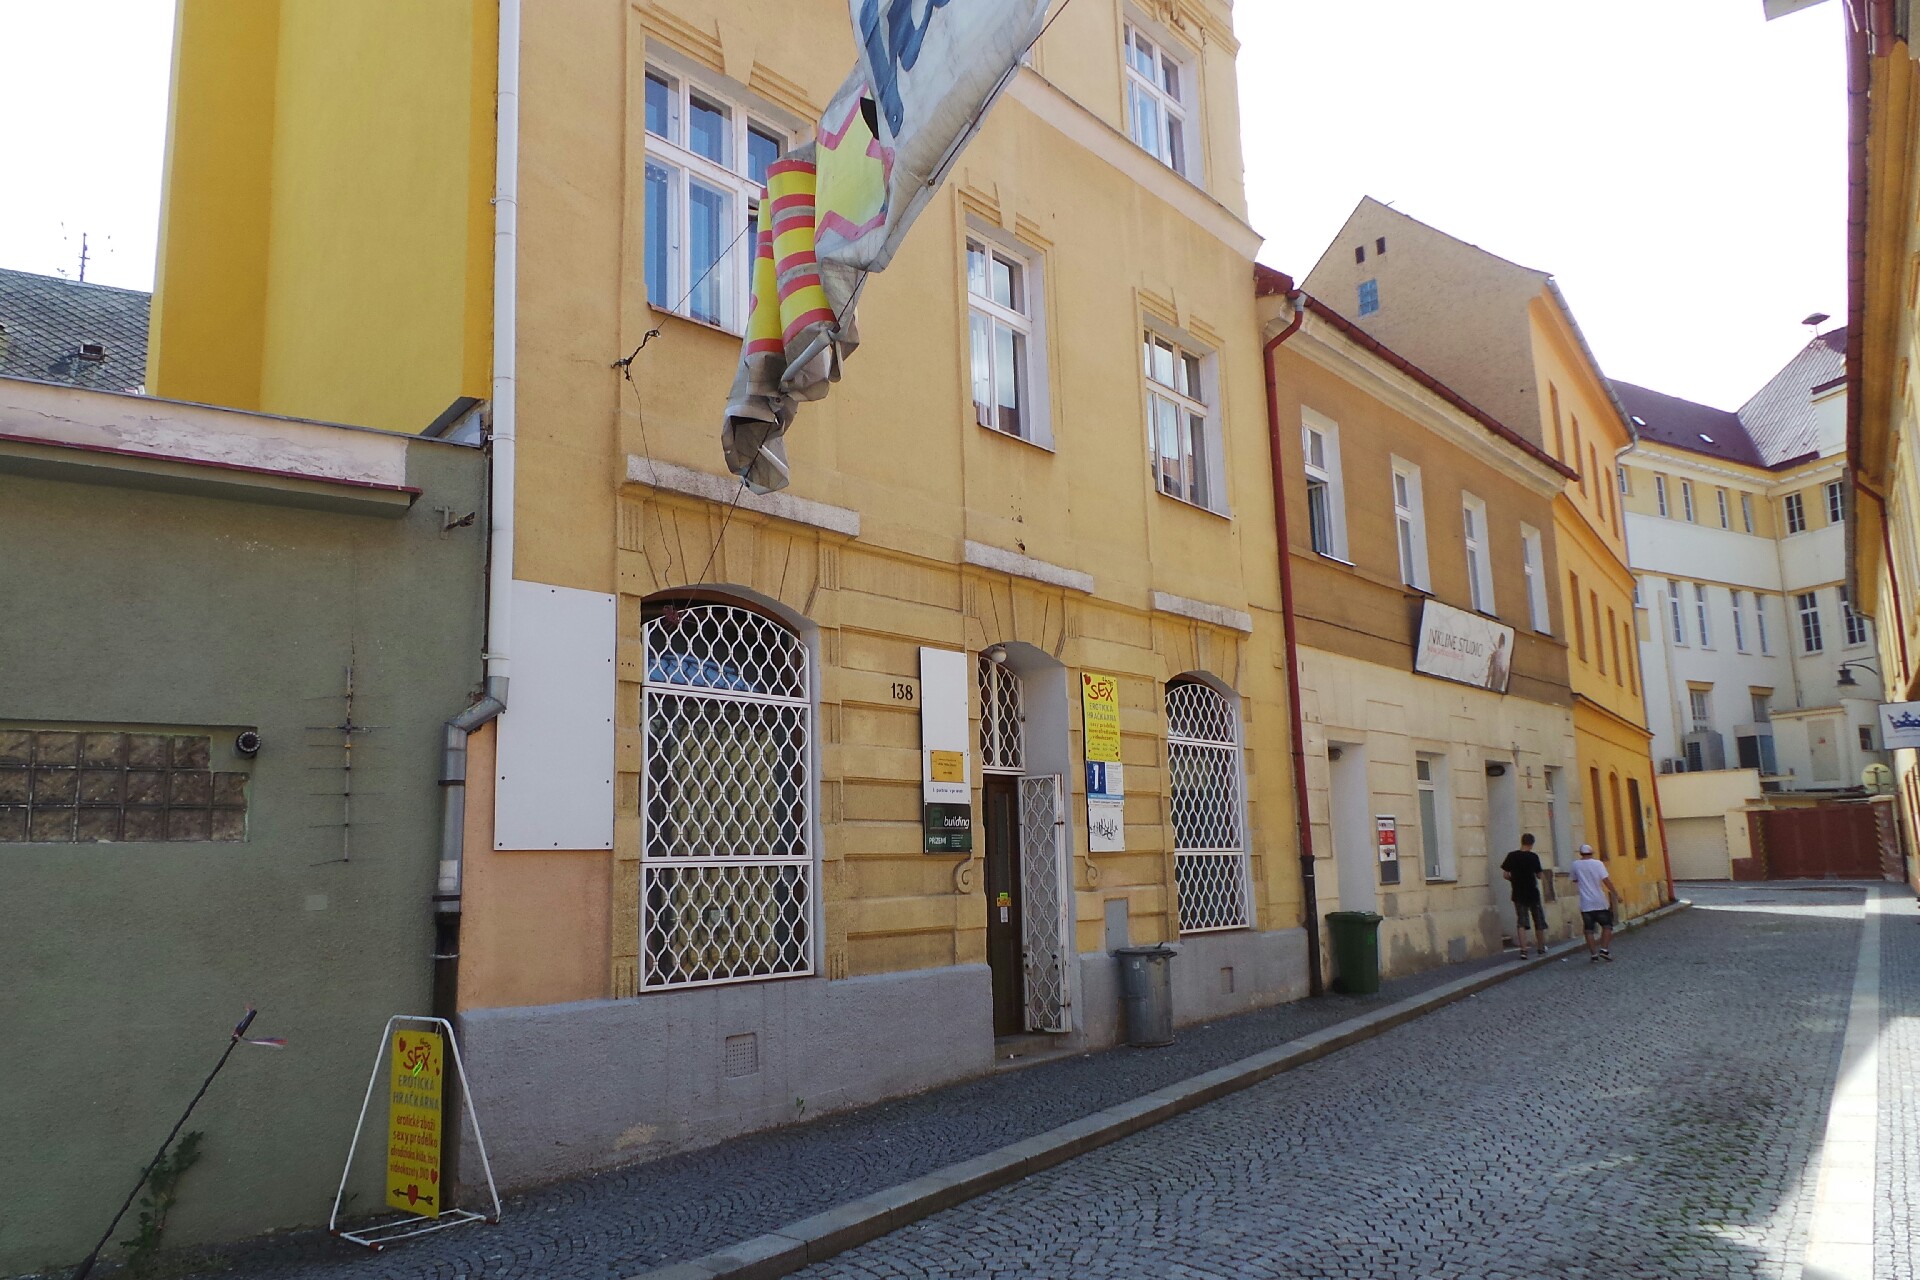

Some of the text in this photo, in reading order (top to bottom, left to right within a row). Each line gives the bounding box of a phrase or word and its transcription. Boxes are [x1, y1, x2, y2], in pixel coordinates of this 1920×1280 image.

[1458, 637, 1484, 658] STUDIO
[890, 682, 914, 701] 138
[1087, 682, 1114, 702] SEX
[943, 815, 970, 830] building
[403, 1046, 431, 1072] SEX
[392, 1130, 409, 1145] sexy
